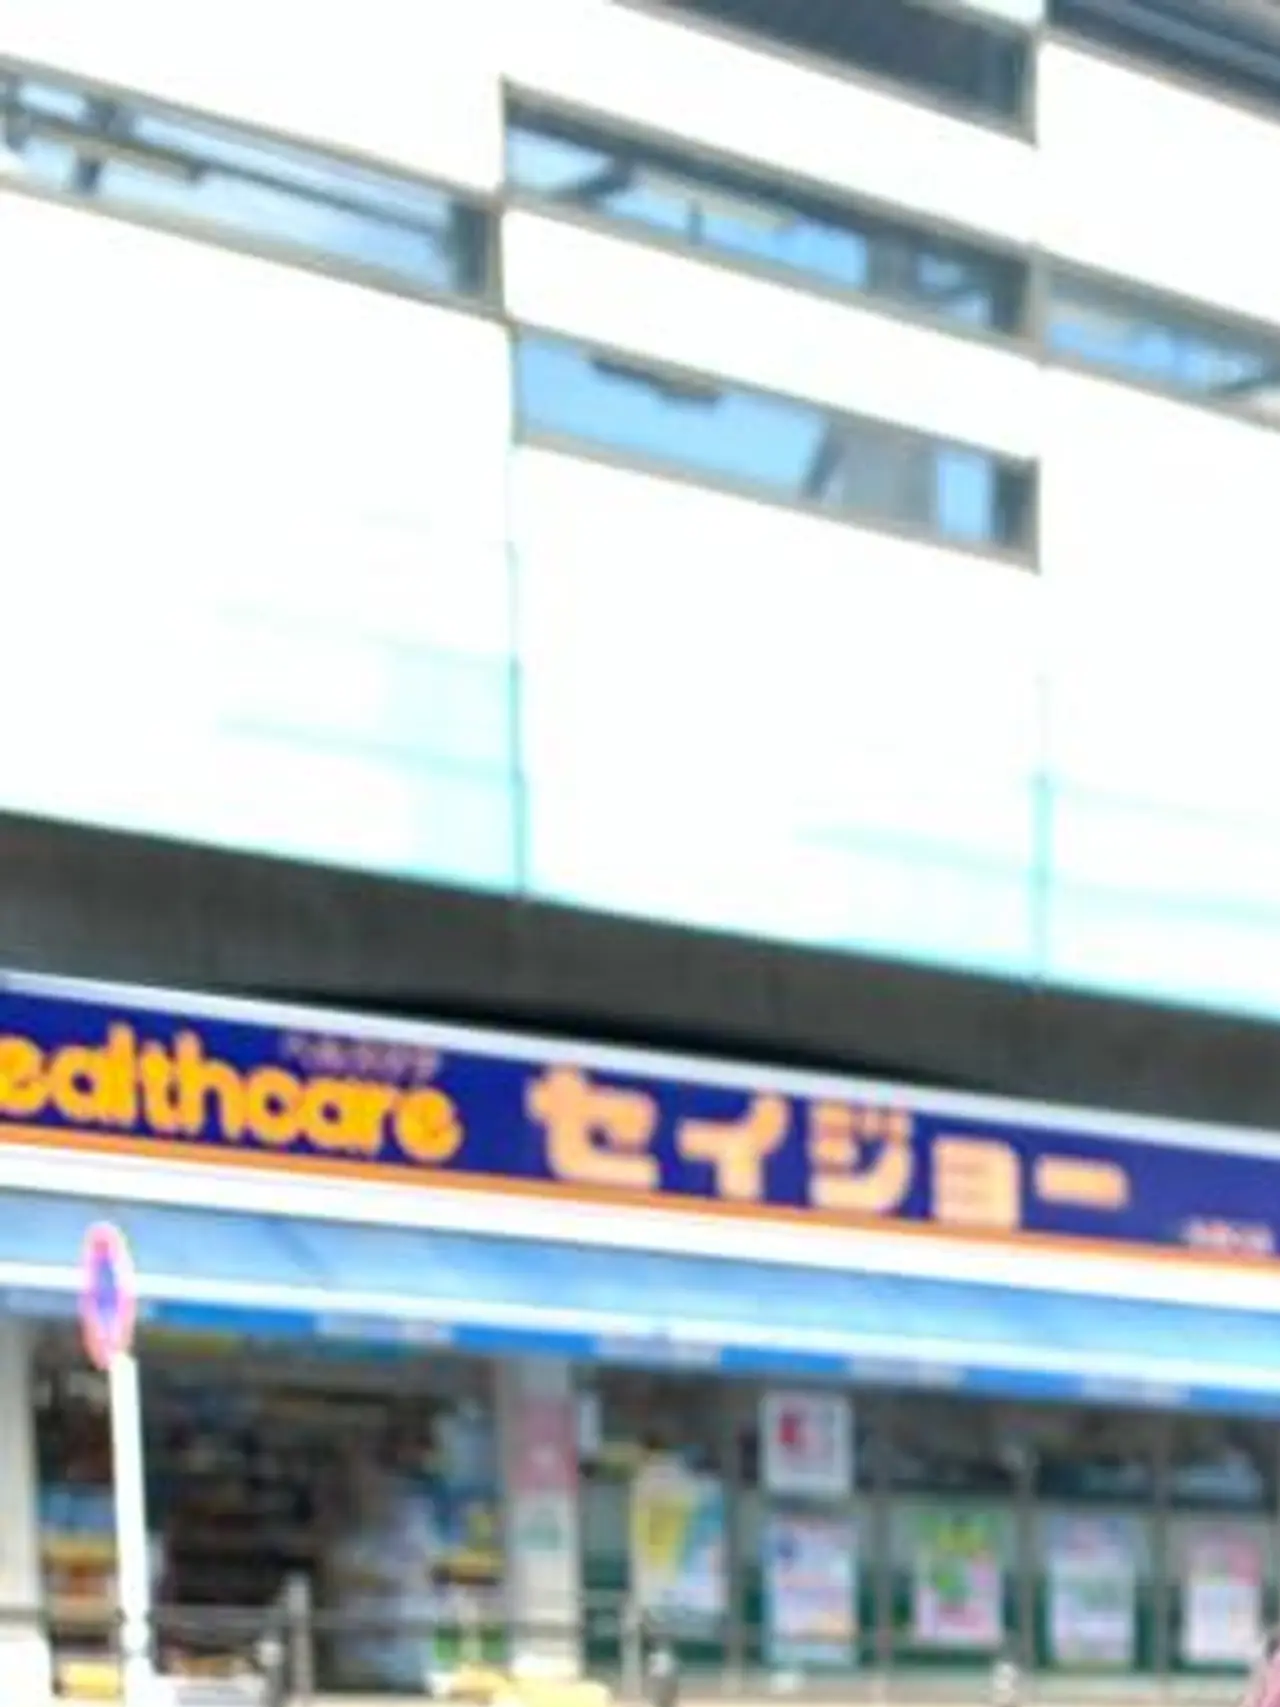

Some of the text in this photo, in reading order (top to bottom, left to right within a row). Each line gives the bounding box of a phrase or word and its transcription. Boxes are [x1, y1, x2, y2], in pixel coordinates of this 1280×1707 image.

[527, 1063, 1129, 1229] セイジョー
